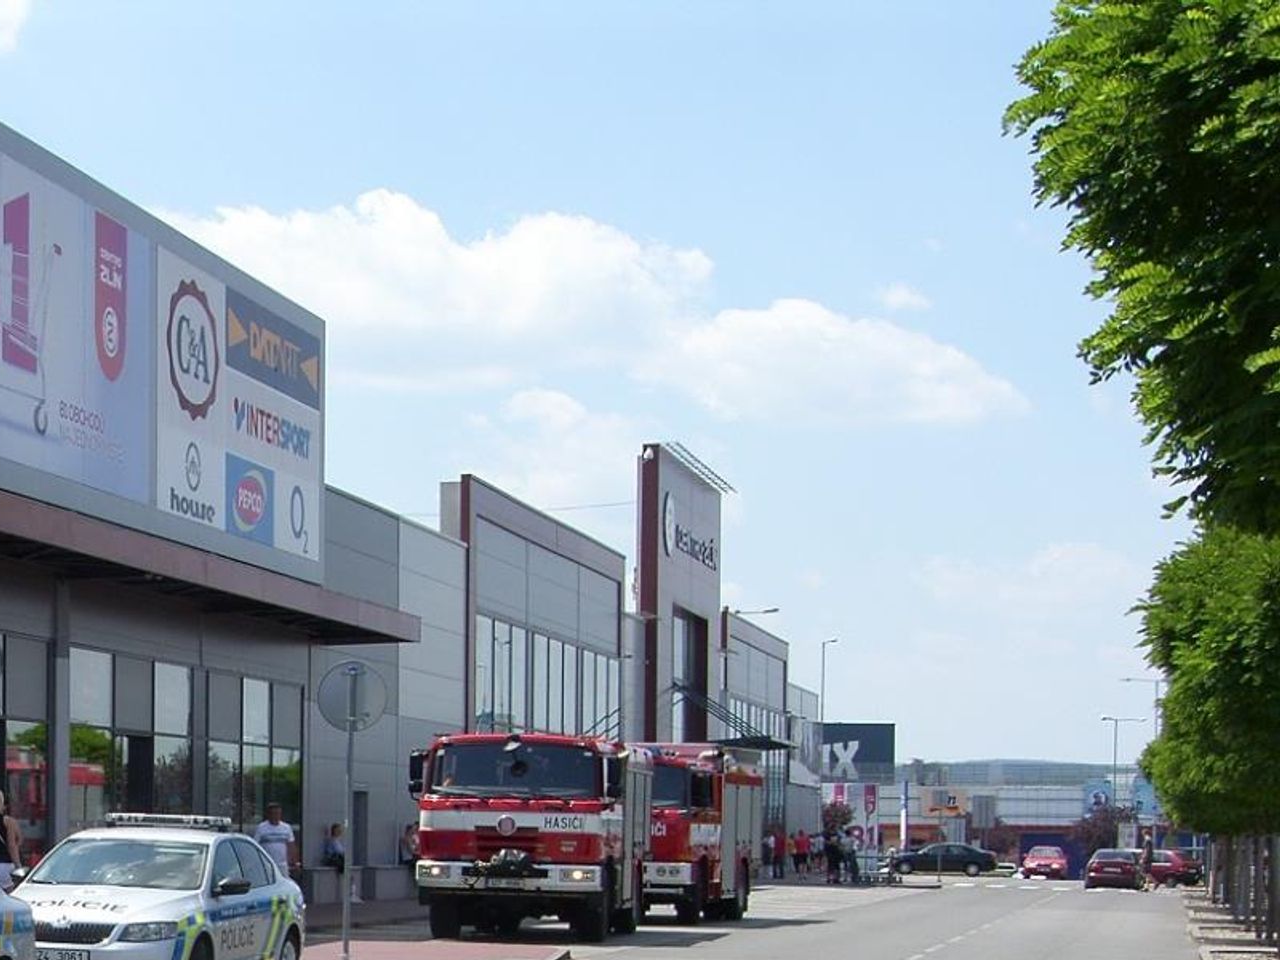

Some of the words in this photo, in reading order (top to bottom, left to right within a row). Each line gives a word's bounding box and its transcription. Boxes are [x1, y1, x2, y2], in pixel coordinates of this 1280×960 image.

[176, 314, 210, 385] C&A
[246, 402, 311, 459] INTERSPORT
[170, 486, 215, 523] house
[238, 487, 262, 514] PEPCO
[31, 899, 128, 914] OLICIE
